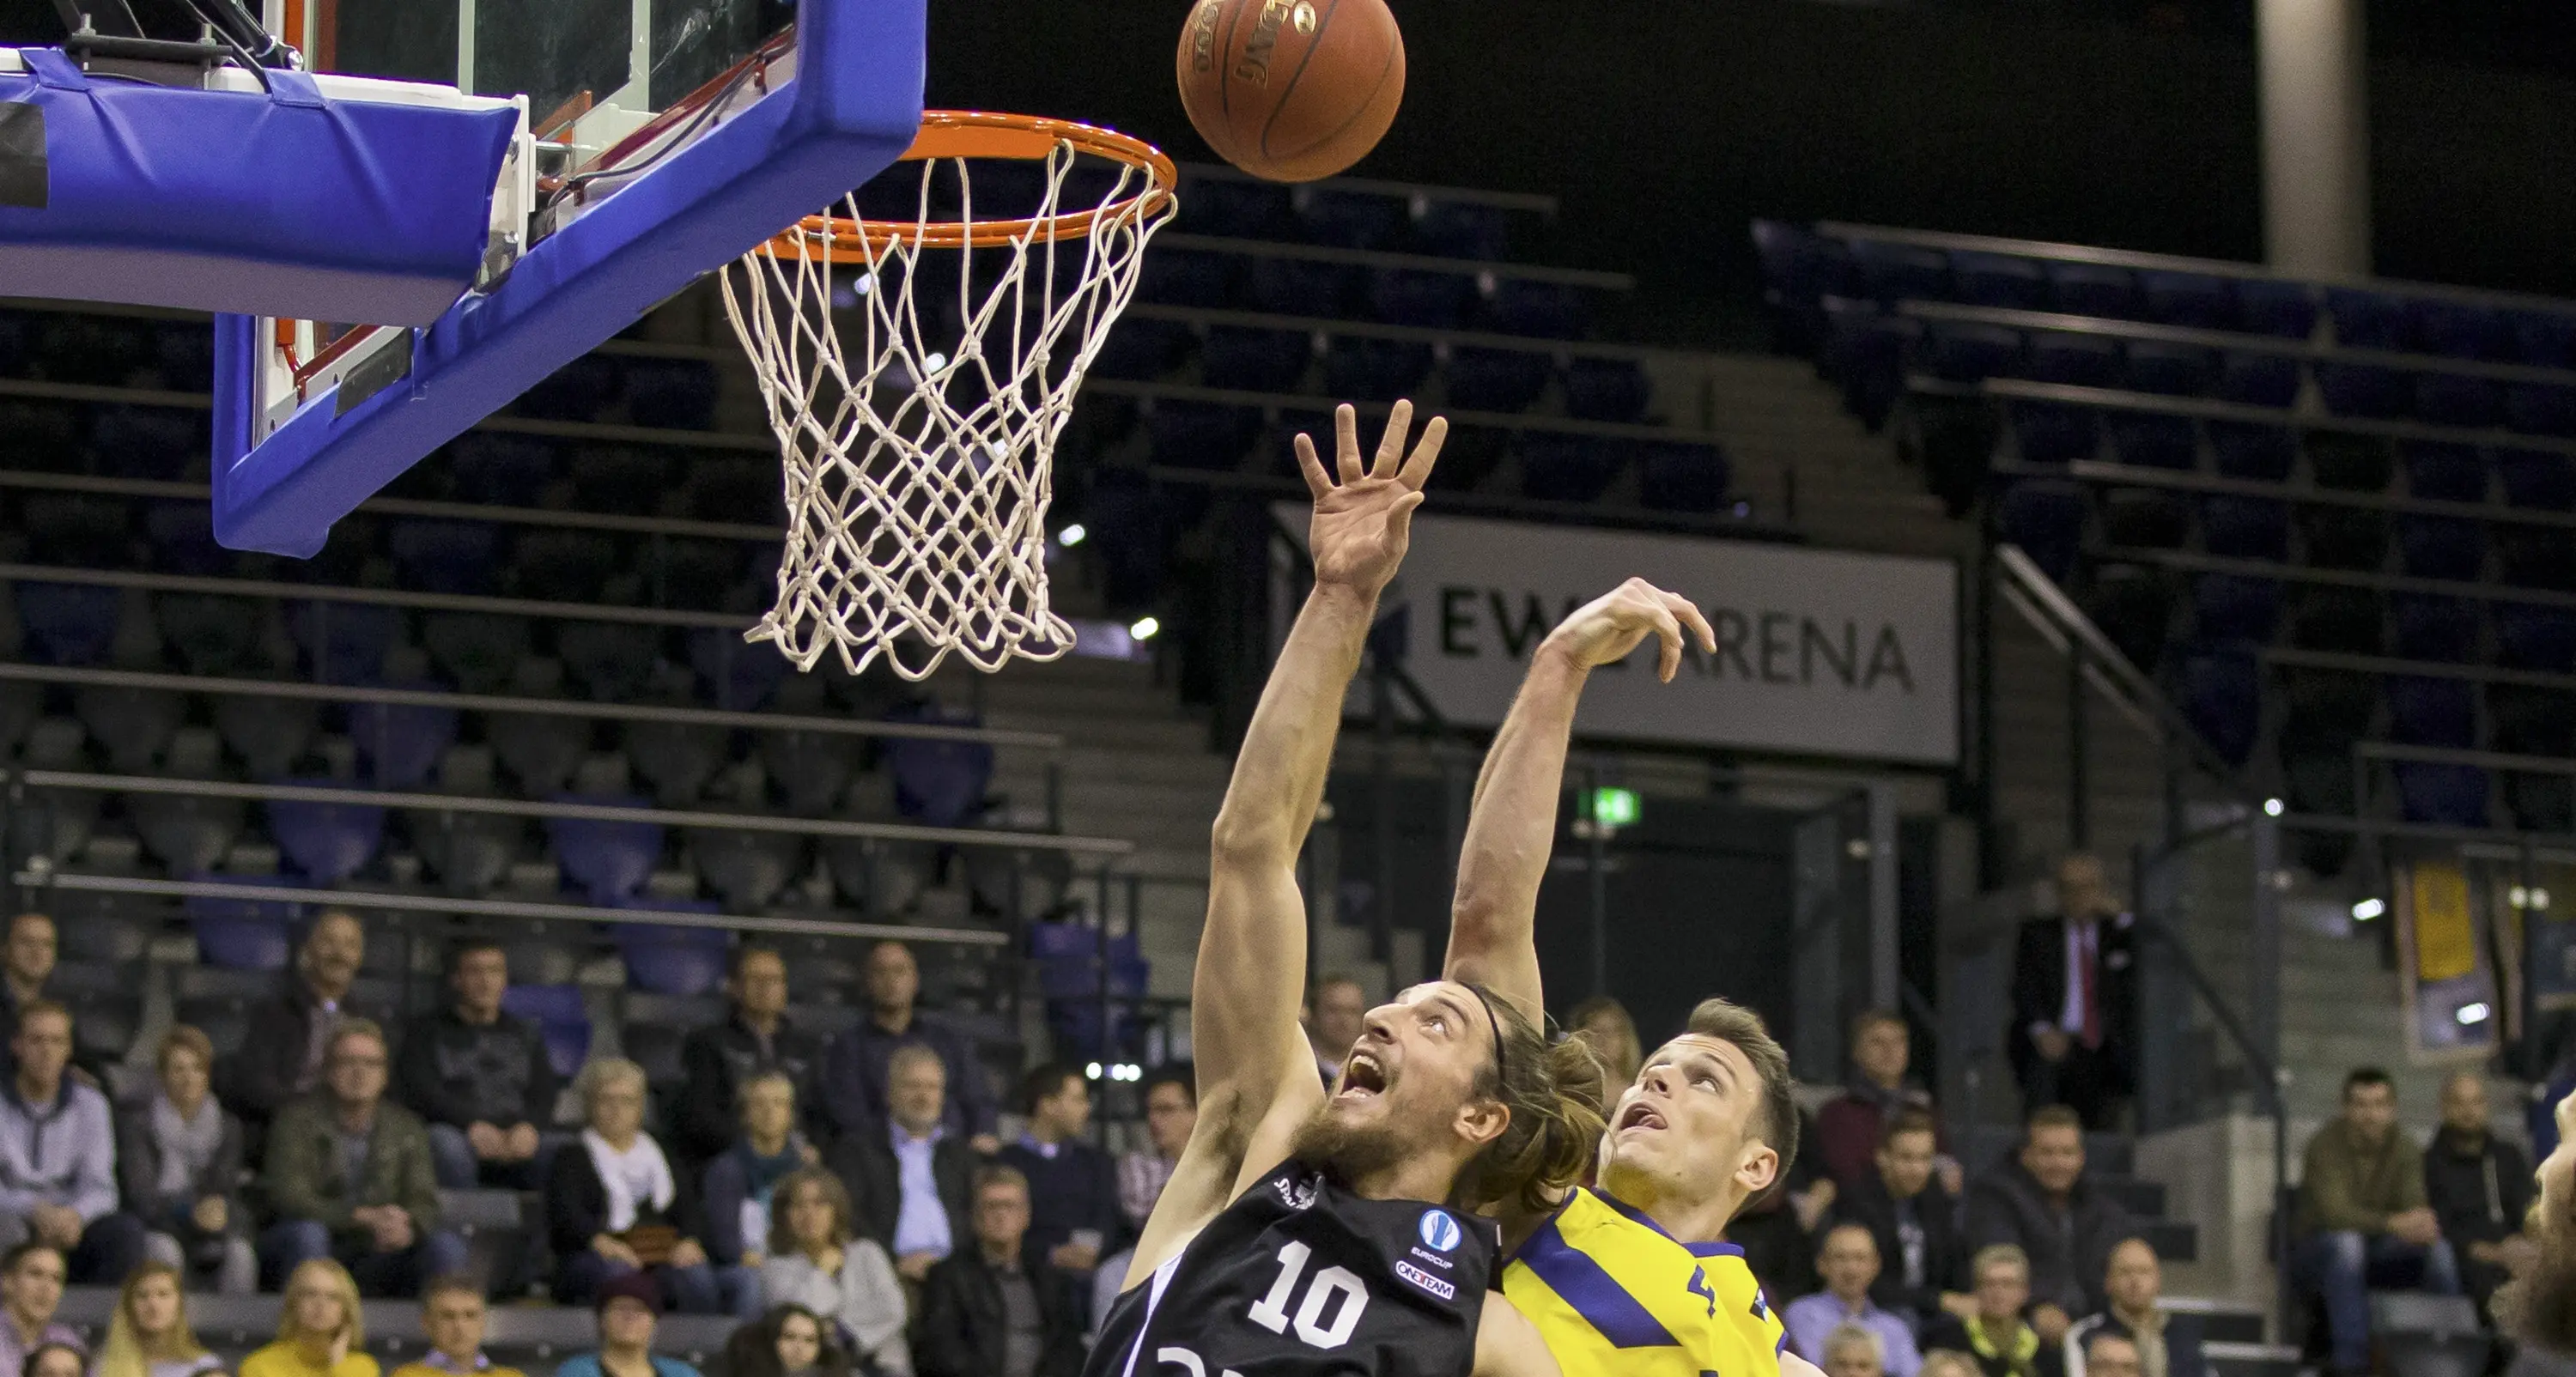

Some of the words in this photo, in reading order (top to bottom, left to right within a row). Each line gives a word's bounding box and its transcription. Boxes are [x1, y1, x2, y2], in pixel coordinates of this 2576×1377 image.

[1440, 584, 1628, 666] EW
[1248, 1240, 1370, 1350] 10
[1411, 1247, 1454, 1270] EUROCUP
